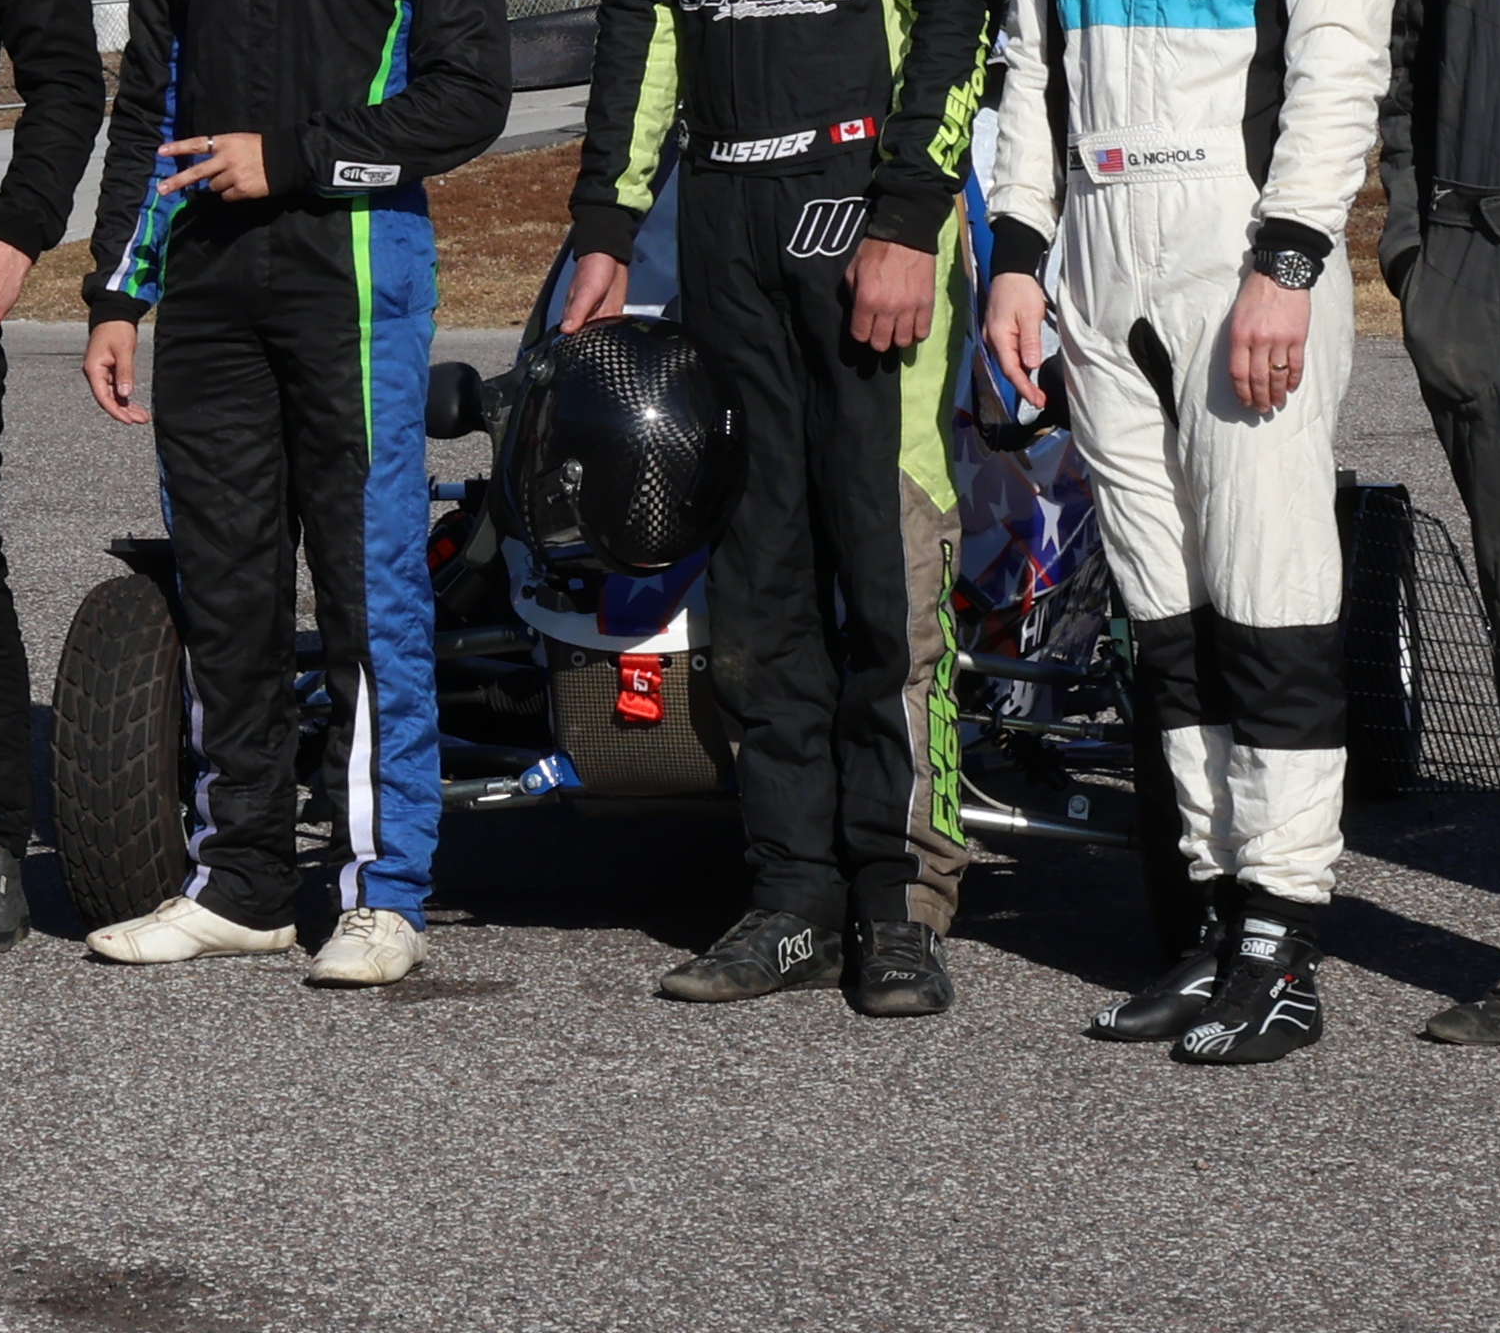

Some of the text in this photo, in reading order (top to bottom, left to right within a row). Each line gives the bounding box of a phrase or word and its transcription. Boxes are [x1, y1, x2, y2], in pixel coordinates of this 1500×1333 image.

[710, 129, 817, 163] LUSSIER
[1144, 149, 1206, 165] NICHOLS
[343, 168, 360, 180] sfi
[779, 928, 813, 974] K1
[1241, 939, 1278, 956] OMP
